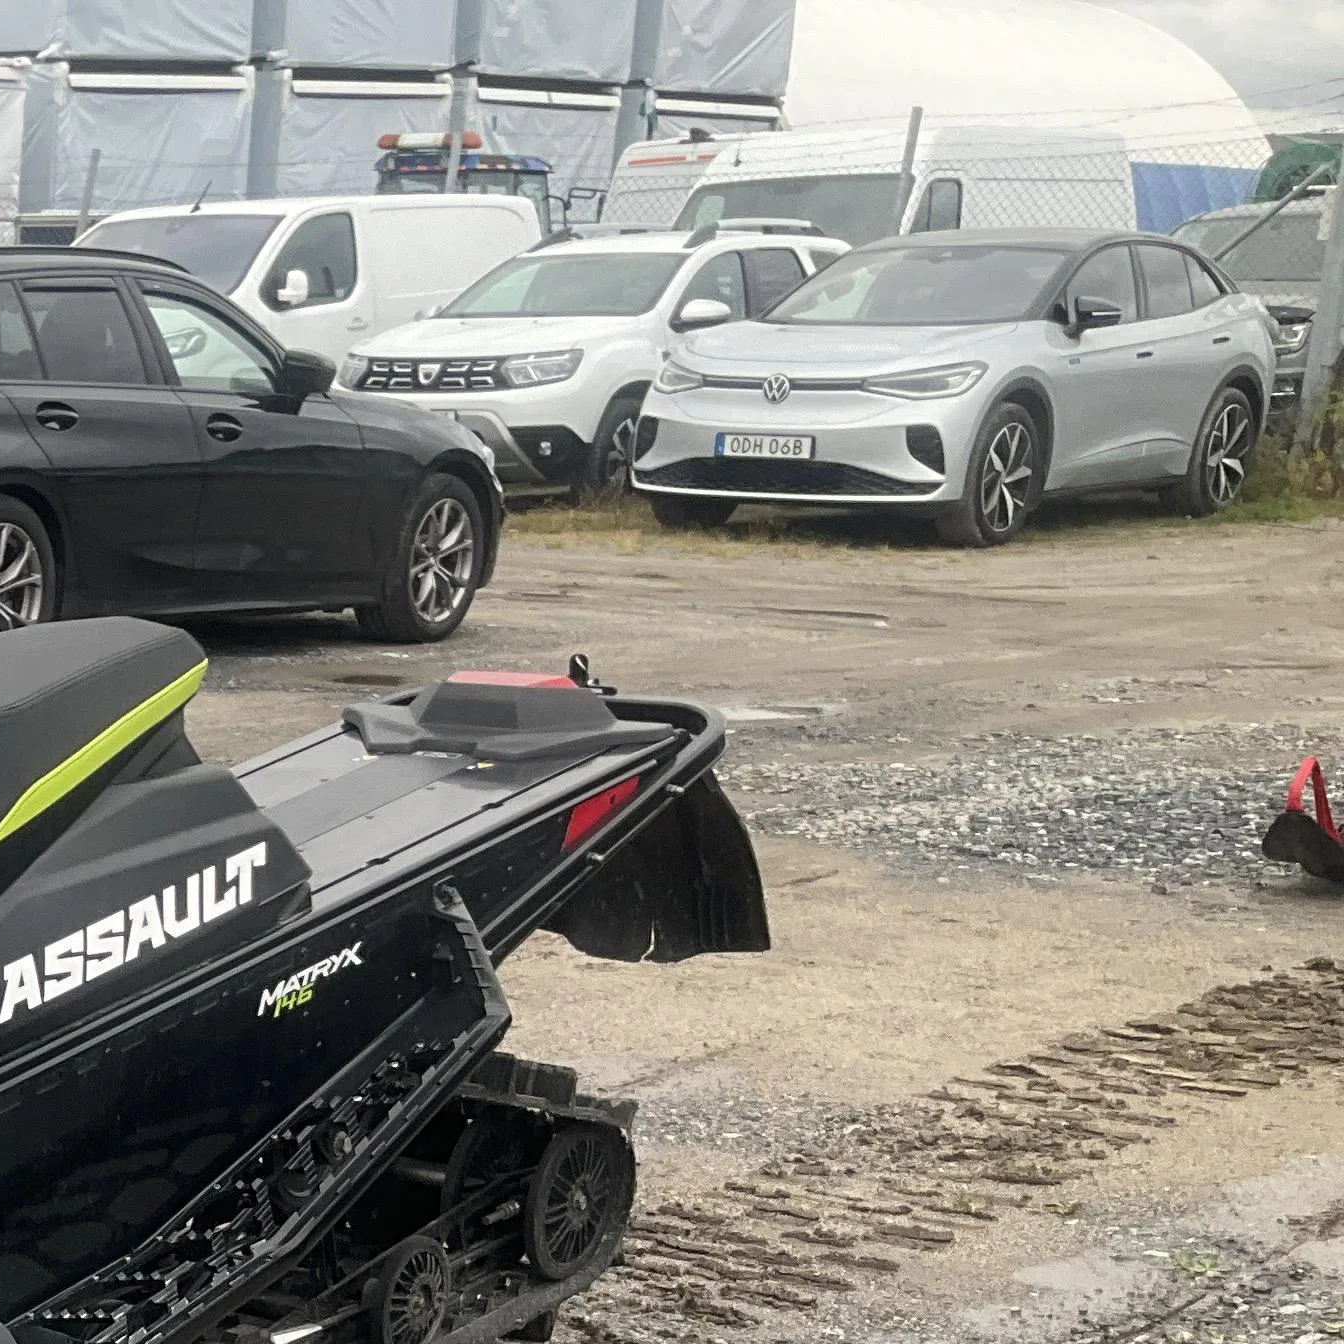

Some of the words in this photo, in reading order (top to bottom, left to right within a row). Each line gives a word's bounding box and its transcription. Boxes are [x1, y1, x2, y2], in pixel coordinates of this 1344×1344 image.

[730, 437, 763, 455] ODH
[769, 438, 803, 456] 06B
[257, 940, 363, 1018] MATRYX
[273, 983, 314, 1019] 146
